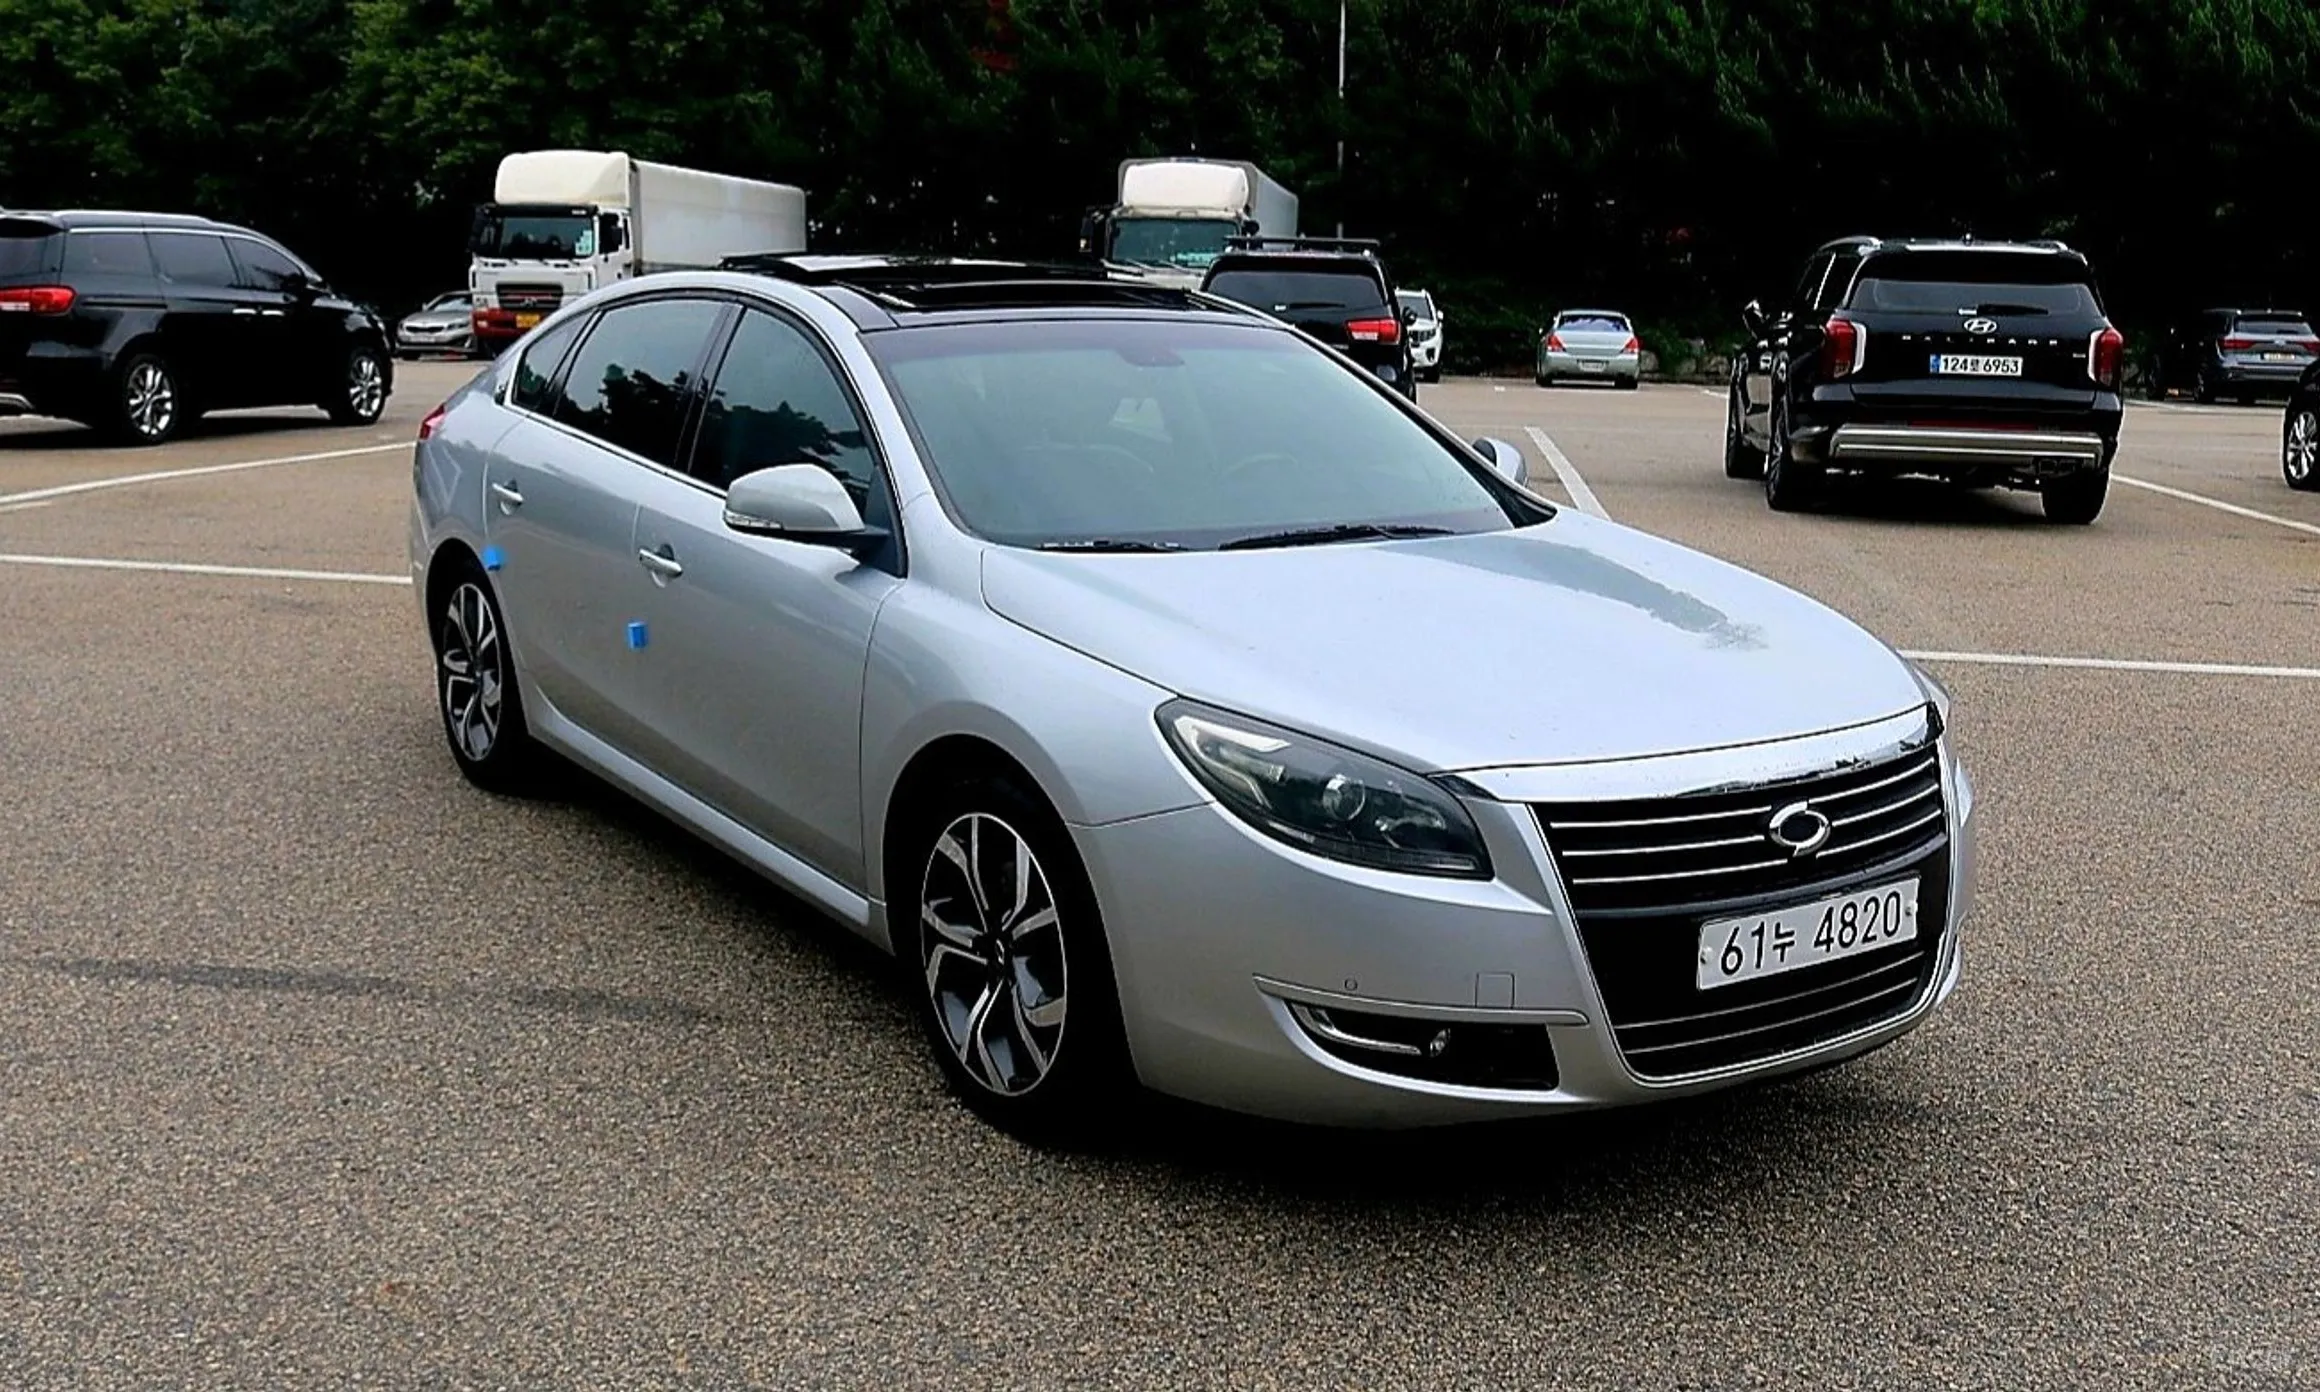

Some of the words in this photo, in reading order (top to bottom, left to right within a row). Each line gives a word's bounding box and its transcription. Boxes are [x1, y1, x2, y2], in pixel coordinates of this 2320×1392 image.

[1983, 357, 2019, 373] 6953
[1720, 920, 1796, 976] 61누
[1813, 890, 1902, 953] 4820
